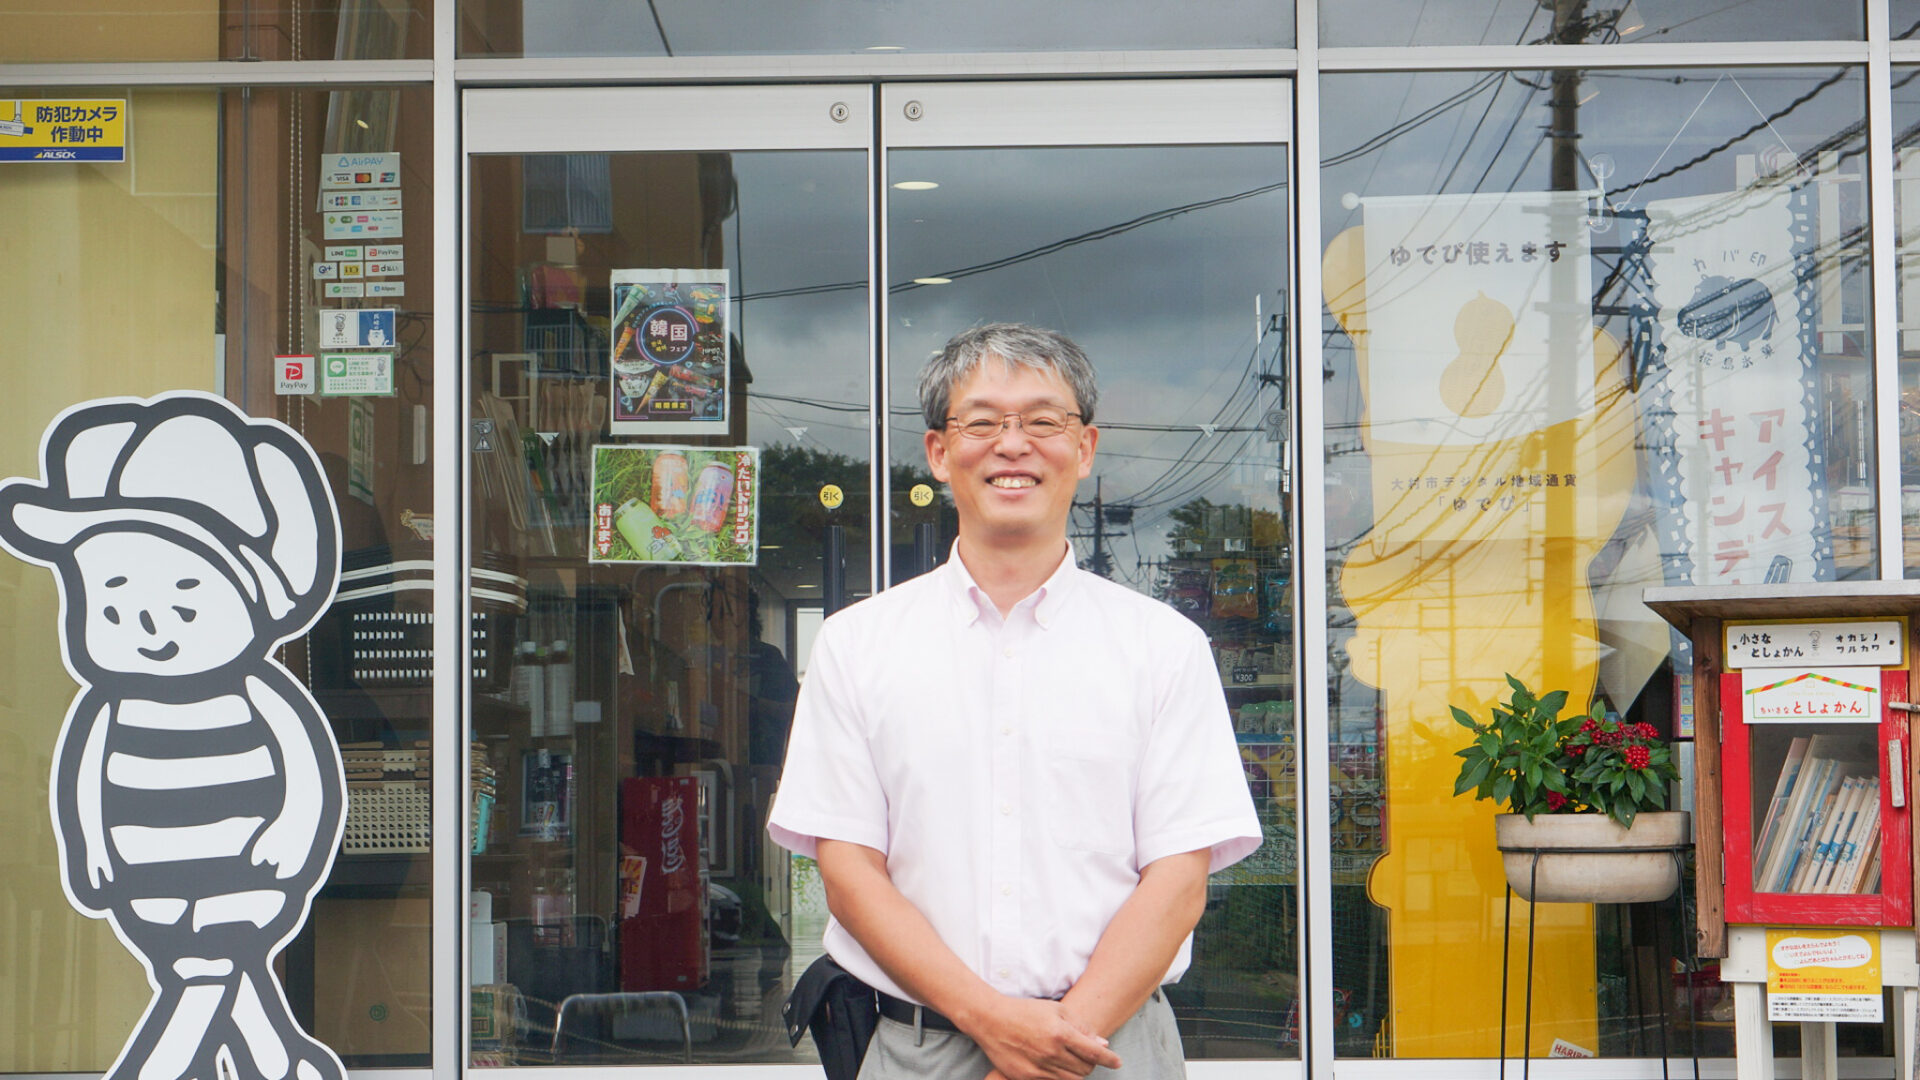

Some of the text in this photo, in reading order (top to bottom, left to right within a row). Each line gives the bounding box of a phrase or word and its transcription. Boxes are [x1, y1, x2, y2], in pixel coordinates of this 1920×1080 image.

[36, 106, 117, 123] 防犯カメラ
[50, 126, 103, 142] 作動中
[42, 151, 76, 159] ALSOK
[1390, 241, 1567, 267] ゆでぴ使えます
[650, 320, 688, 341] 韓国
[280, 381, 309, 389] PayPay
[1391, 474, 1577, 490] 大村市デジタル地域通貨
[1750, 408, 1792, 540] アイス
[735, 454, 752, 544] 冷たいドリンク
[823, 491, 840, 501] 引く
[914, 491, 930, 501] 引く
[1698, 408, 1755, 585] キャンデ
[598, 503, 612, 555] あります
[1740, 633, 1771, 645] 小さな
[1835, 633, 1878, 643] オカシノ
[1751, 646, 1804, 658] としょかん
[1836, 644, 1880, 653] フルカワ
